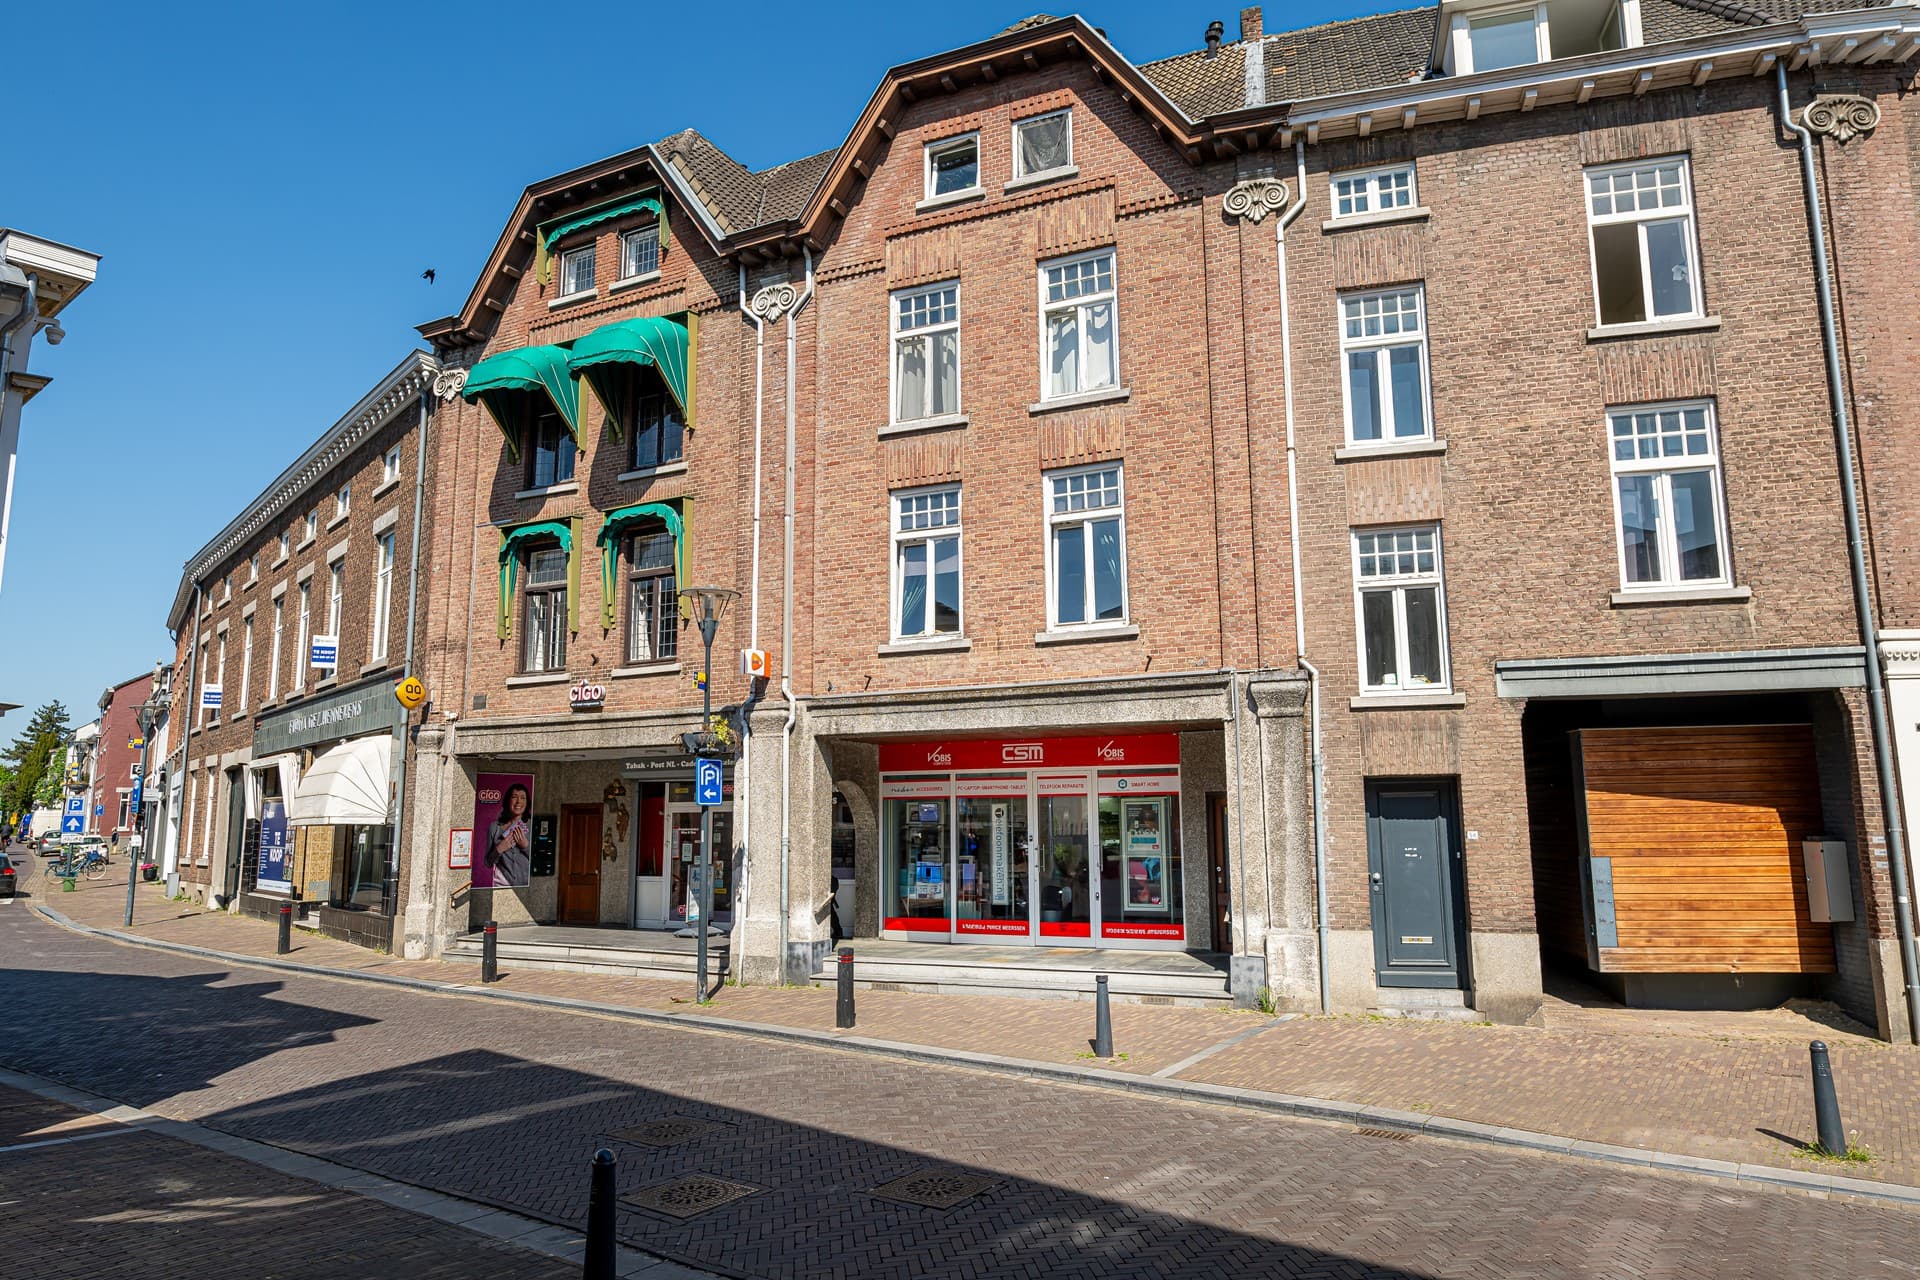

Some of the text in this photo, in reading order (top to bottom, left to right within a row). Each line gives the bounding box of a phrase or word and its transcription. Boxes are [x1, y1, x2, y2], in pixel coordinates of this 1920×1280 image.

[927, 746, 952, 763] VOBIS
[1002, 745, 1044, 761] CSM
[1097, 740, 1125, 758] VOBIS
[650, 761, 665, 769] Post
[72, 800, 81, 810] P
[269, 848, 283, 863] KOOP
